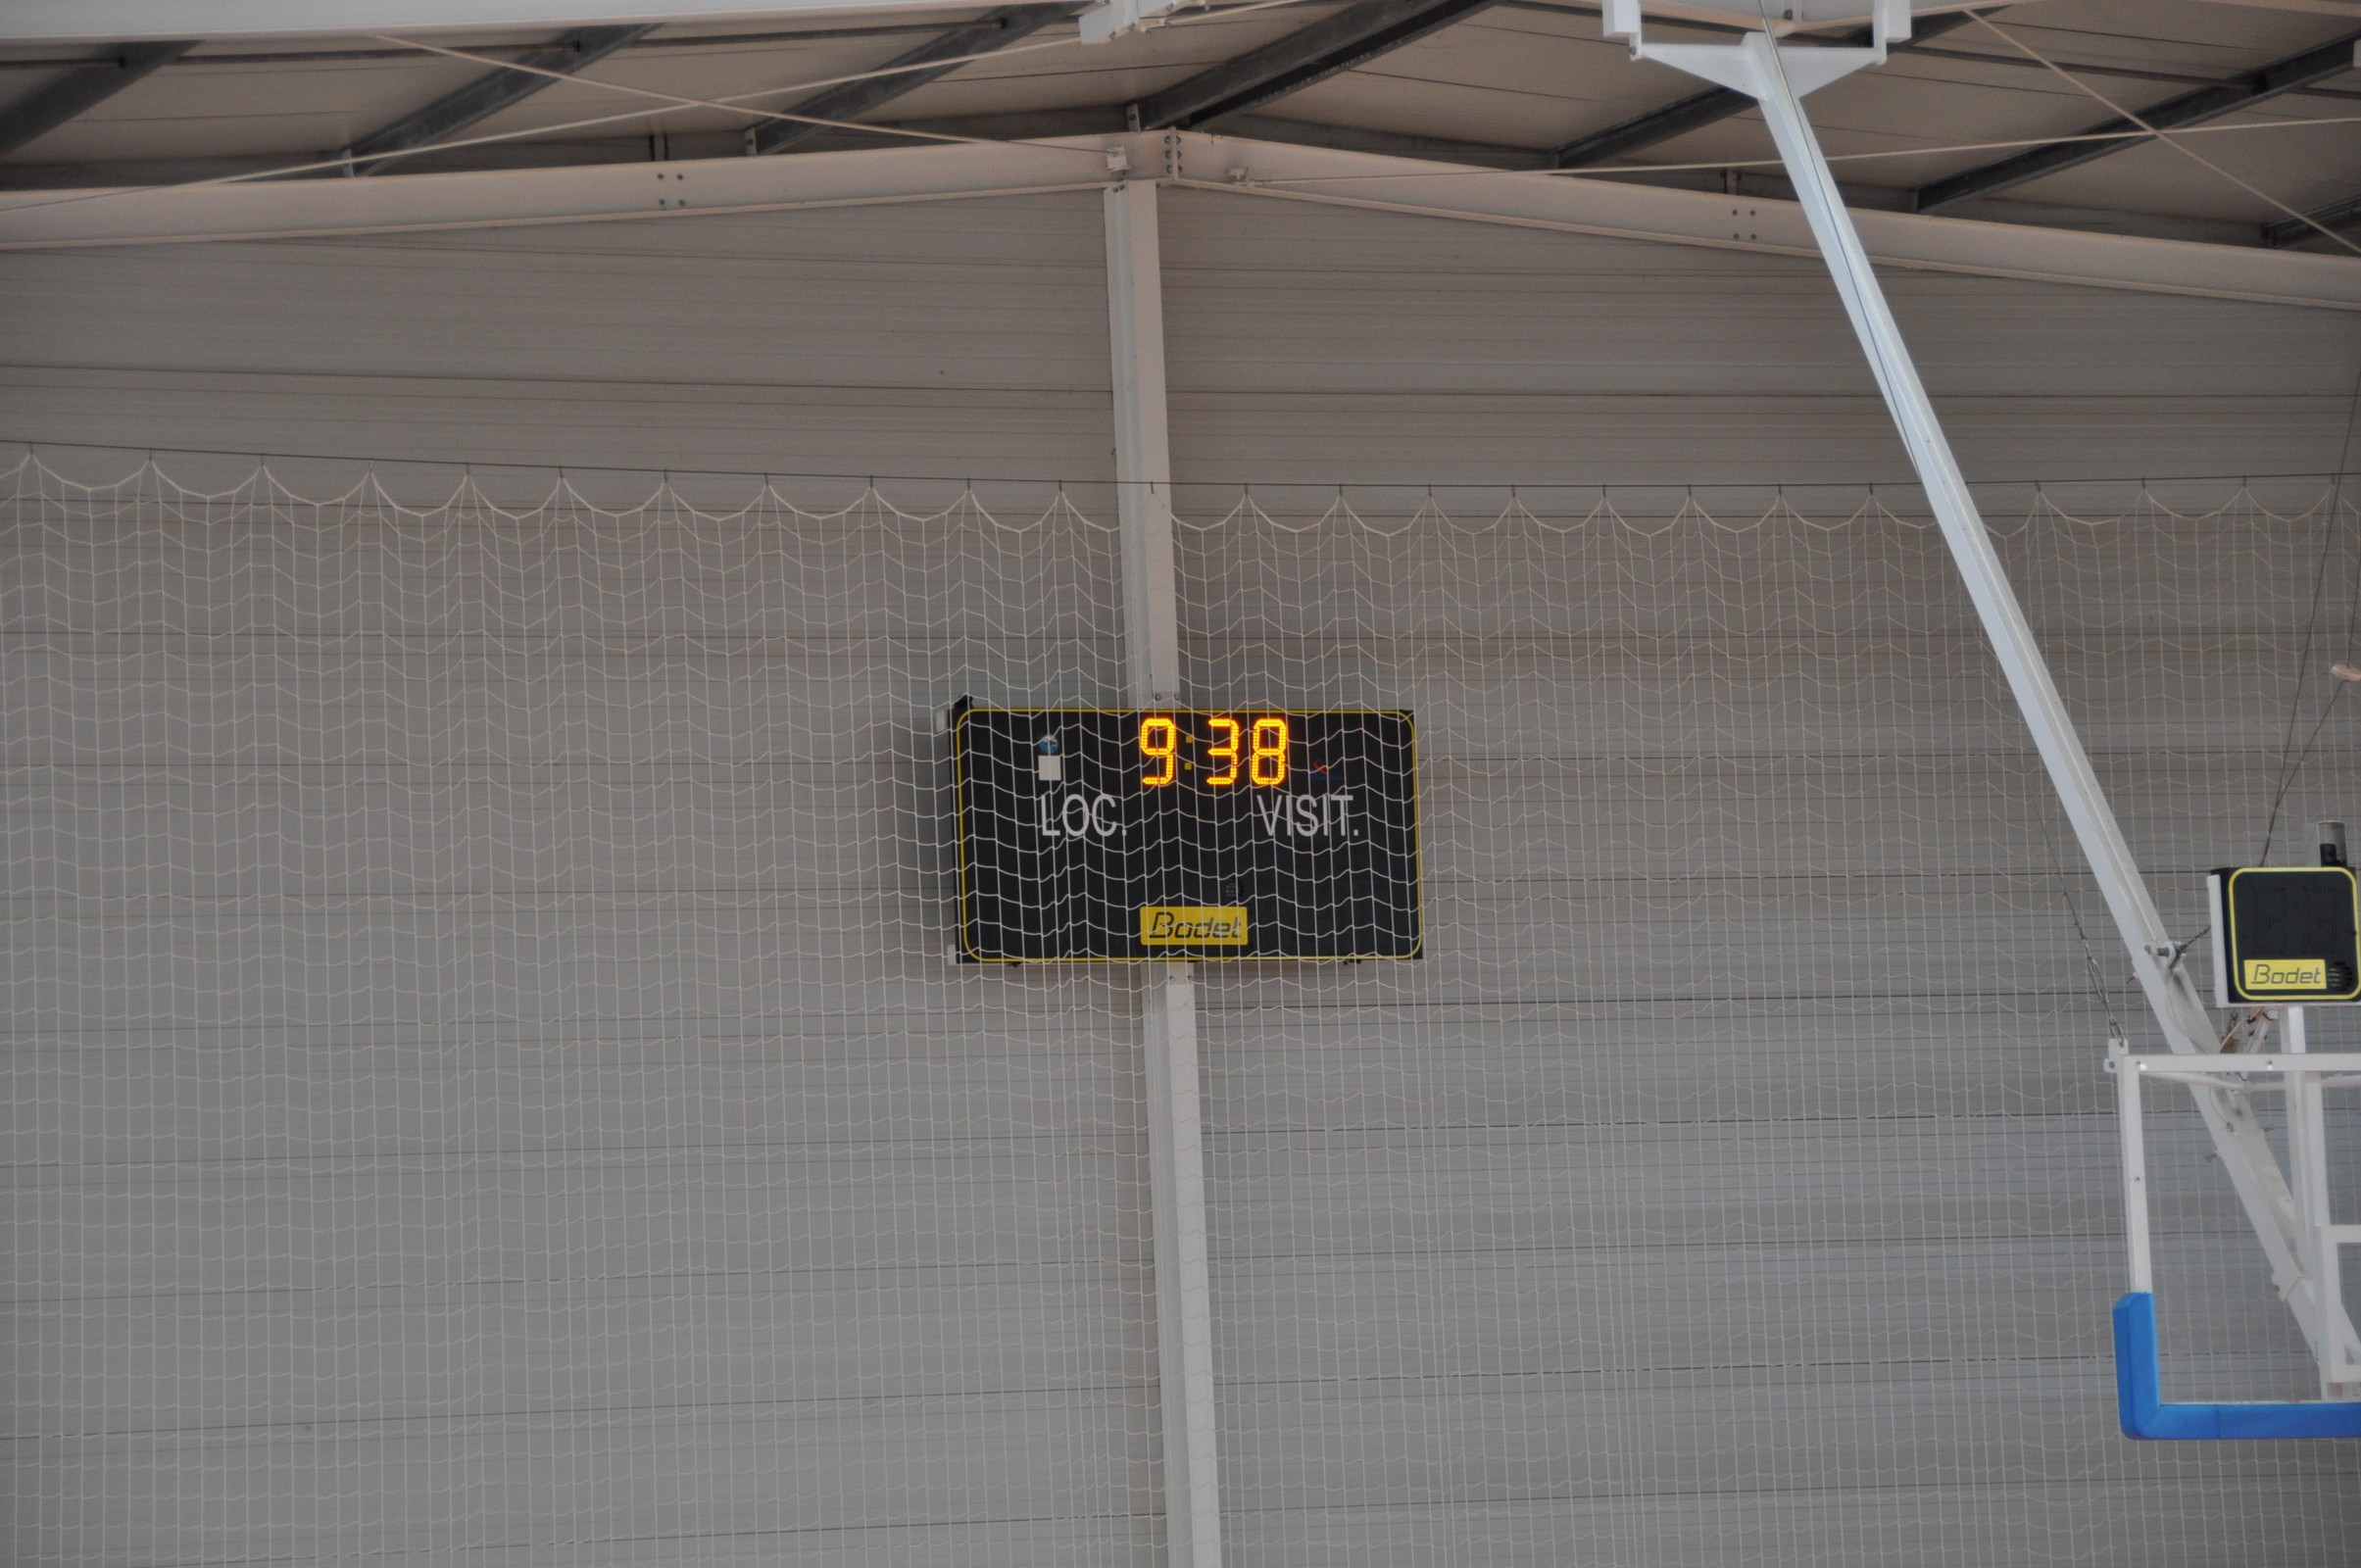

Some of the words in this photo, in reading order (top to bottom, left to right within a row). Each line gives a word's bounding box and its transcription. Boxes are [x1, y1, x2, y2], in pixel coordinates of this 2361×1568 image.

[1040, 794, 1127, 836] LOC.
[1256, 794, 1359, 836] VISIT.
[1148, 910, 1243, 940] Bodet
[2250, 964, 2322, 985] Bodet
